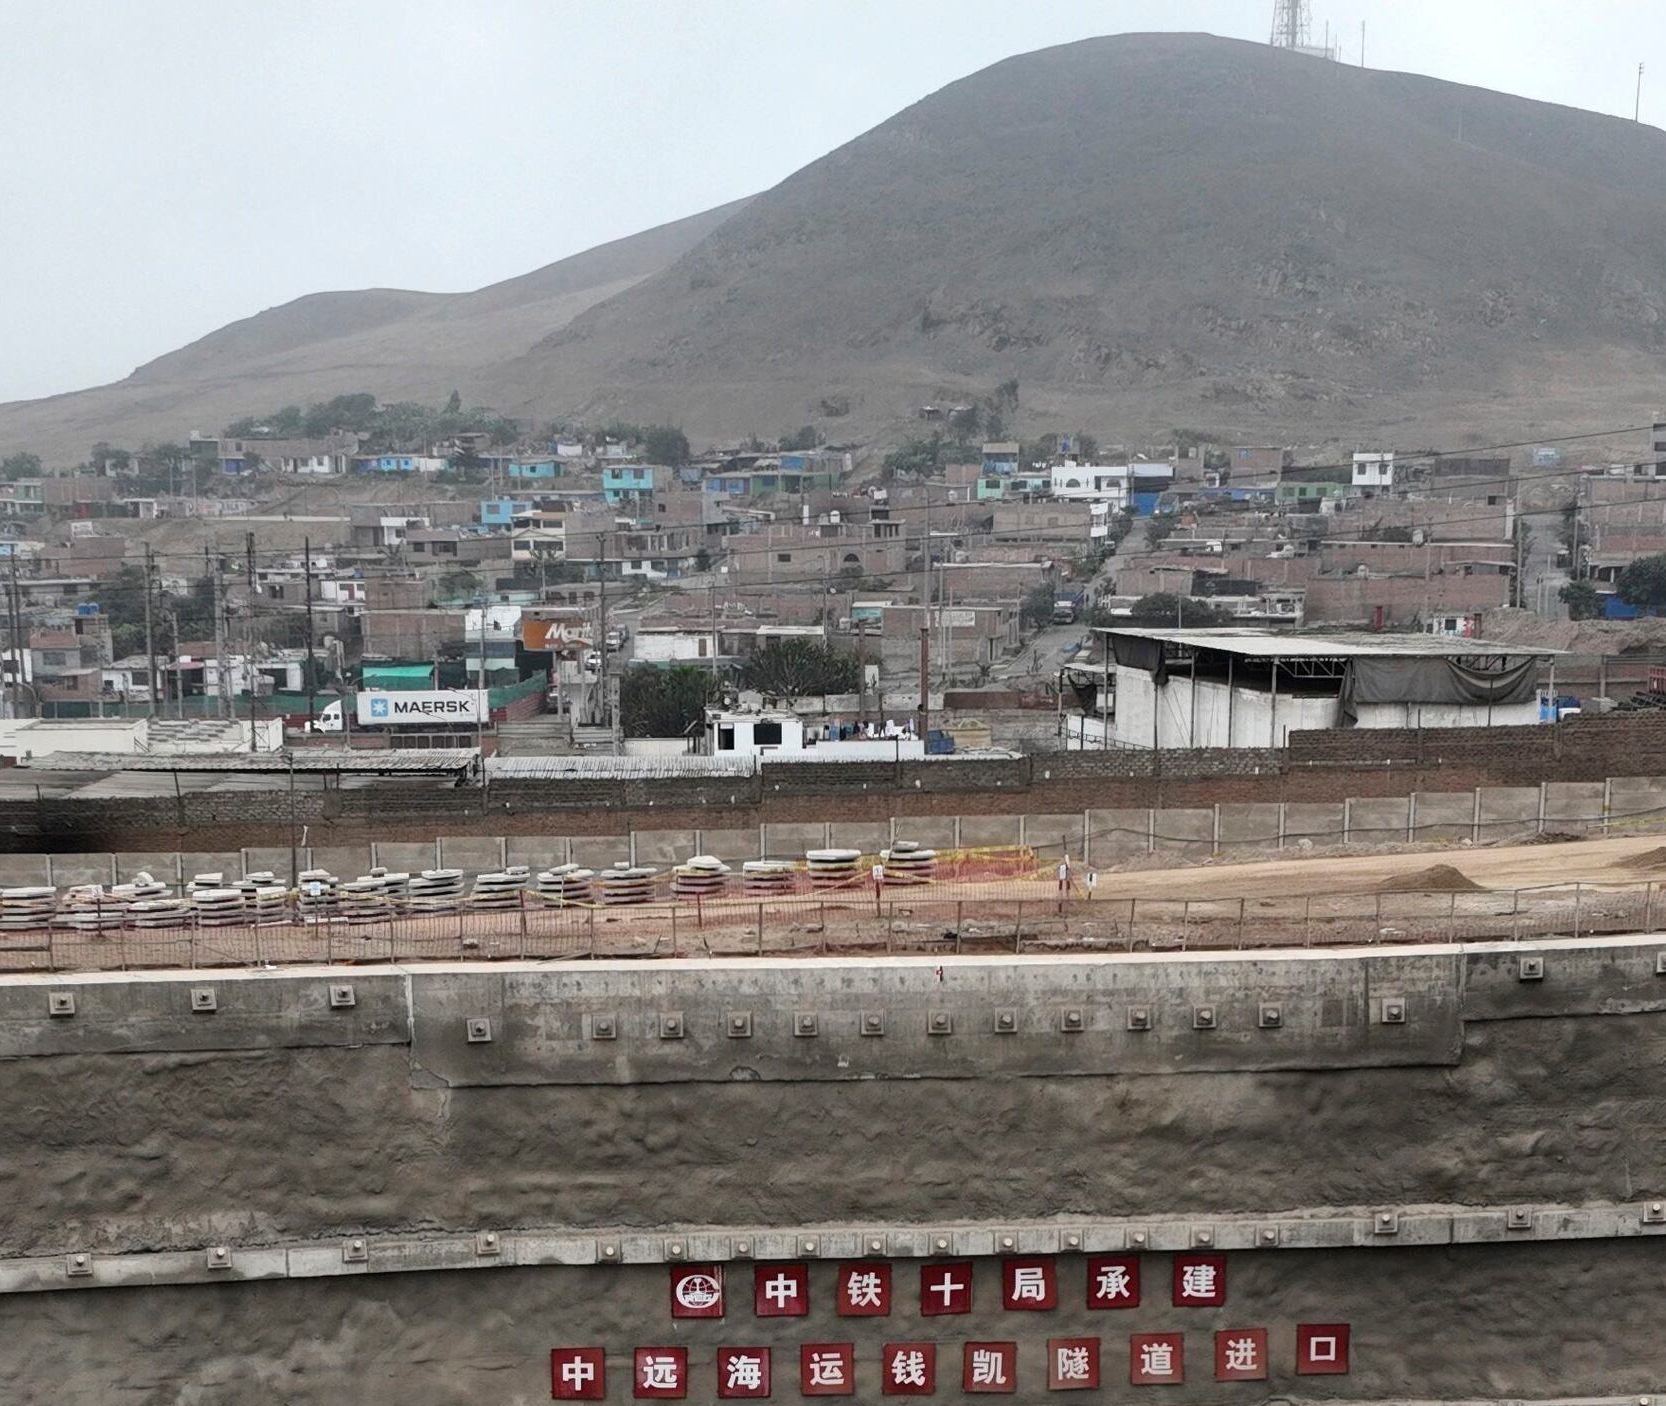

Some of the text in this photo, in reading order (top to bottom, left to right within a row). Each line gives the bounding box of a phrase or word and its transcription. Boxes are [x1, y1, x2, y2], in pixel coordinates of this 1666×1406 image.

[394, 701, 470, 713] MAERSK
[765, 1264, 1216, 1308] 中铁十局承建
[562, 1336, 1337, 1391] 中远海运钱凯隧道进口
